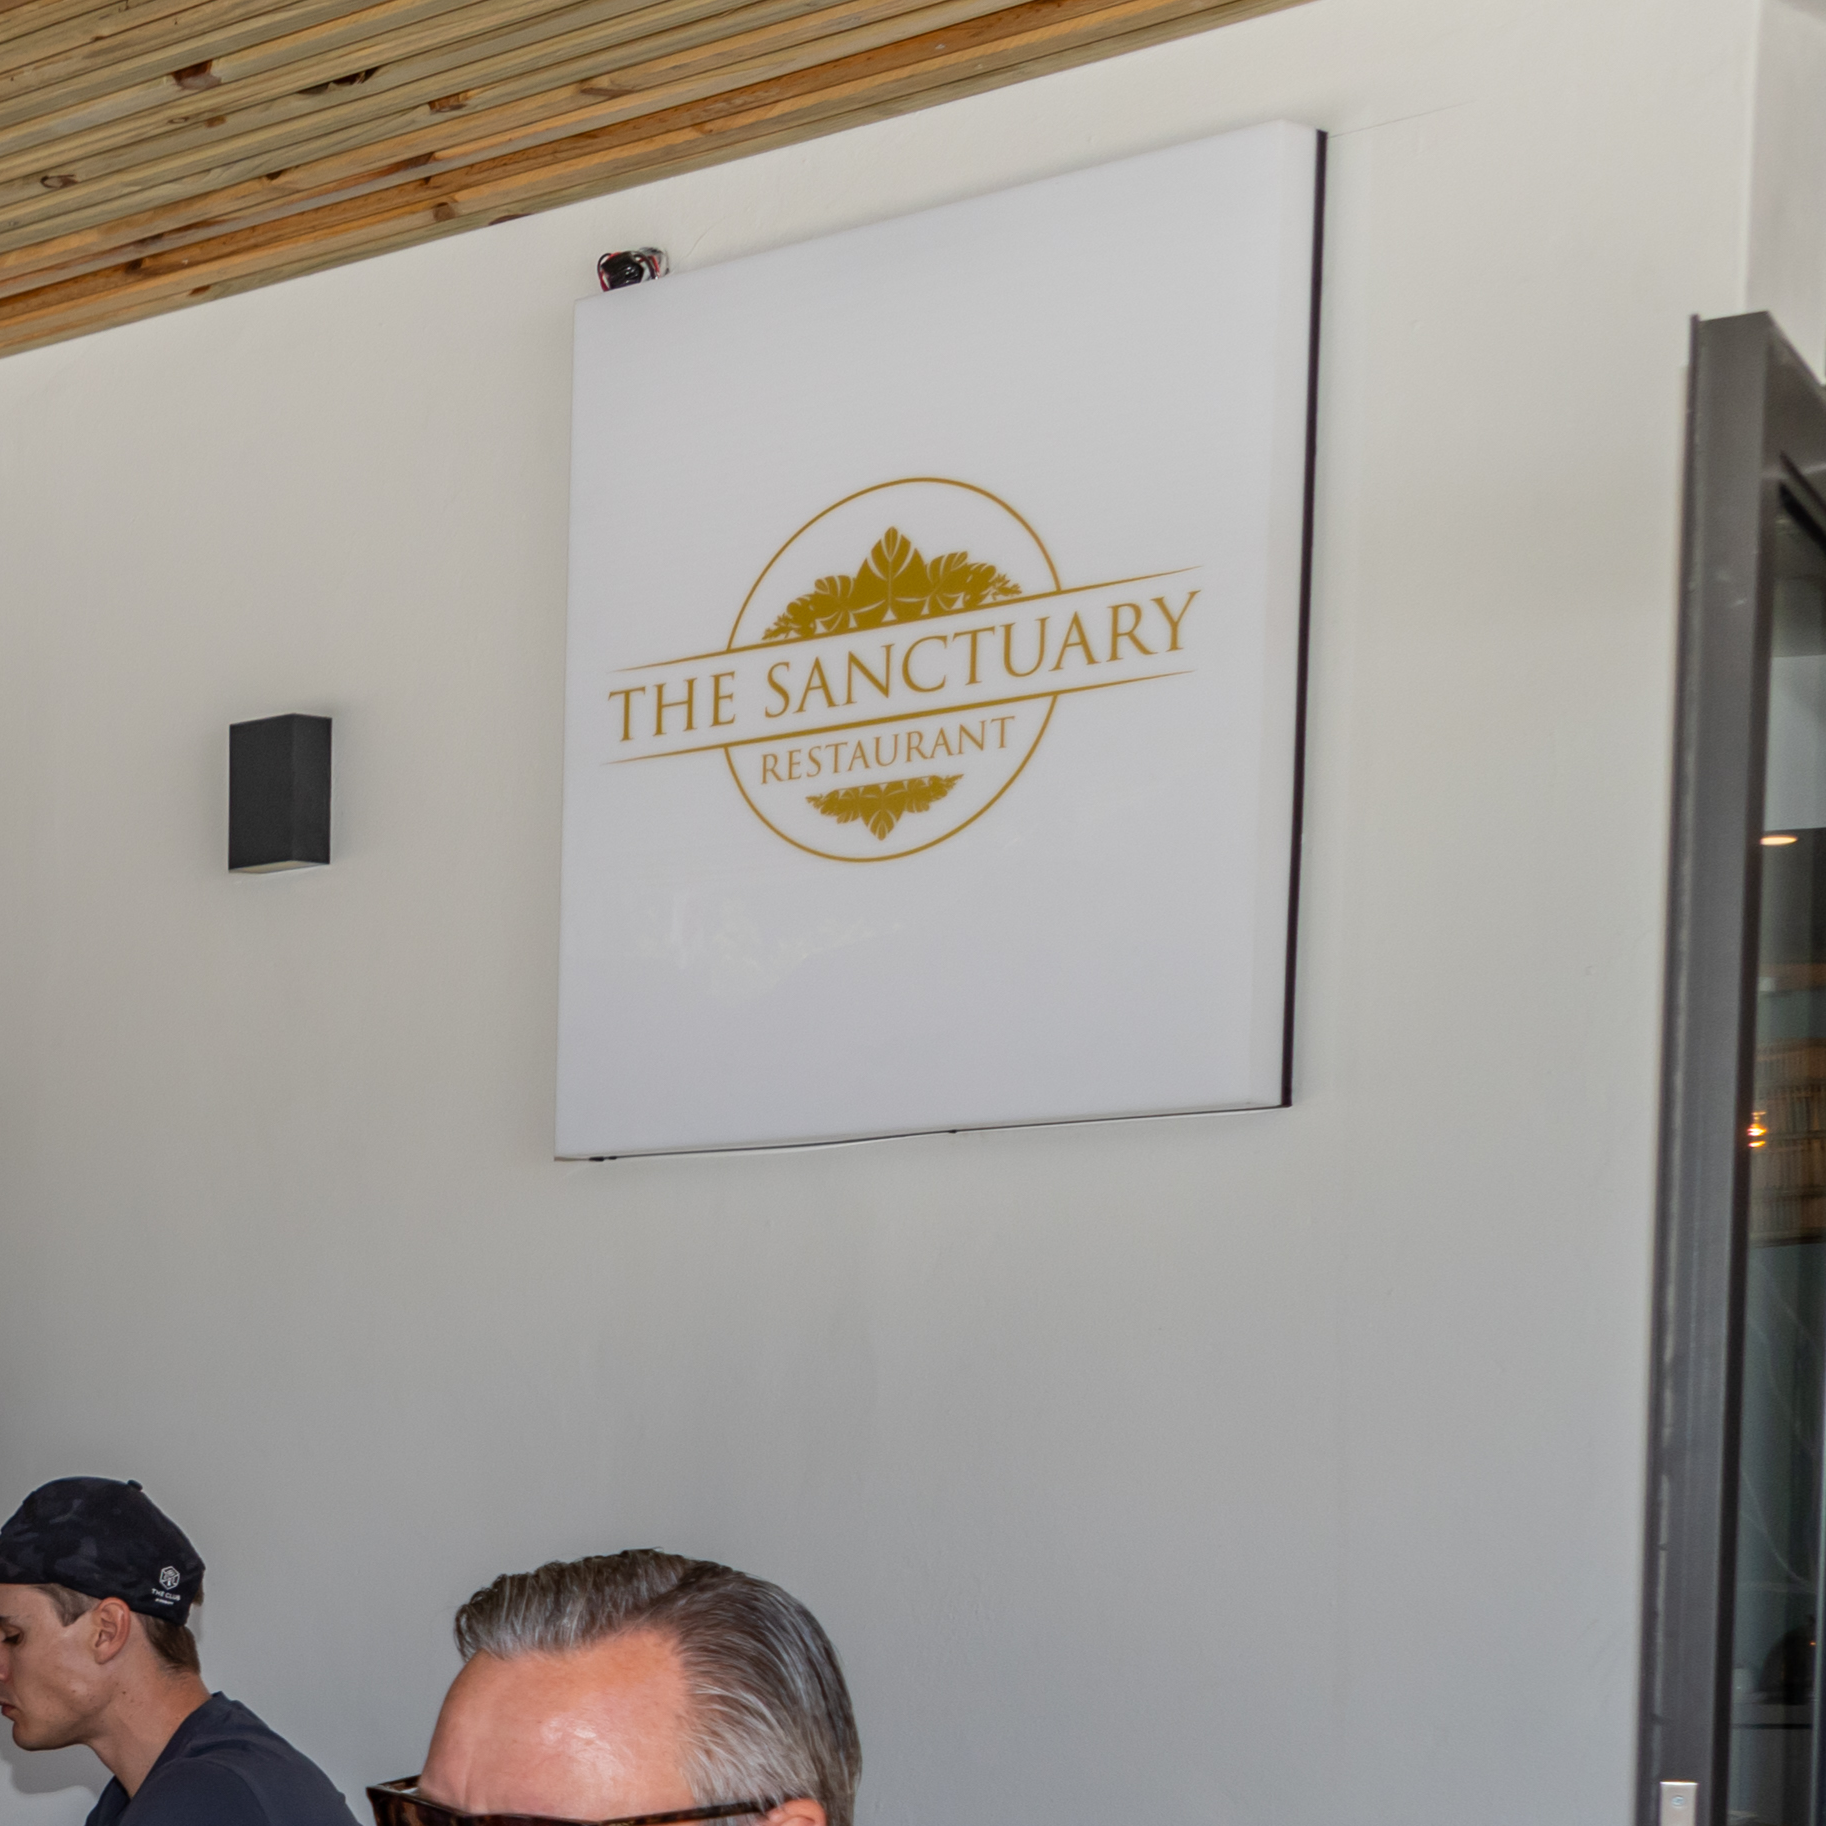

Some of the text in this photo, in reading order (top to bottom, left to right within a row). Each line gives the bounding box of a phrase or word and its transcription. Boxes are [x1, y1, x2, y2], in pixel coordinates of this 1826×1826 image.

[607, 589, 1202, 742] THE SANCTUARY
[760, 715, 1016, 785] RESTAURANT
